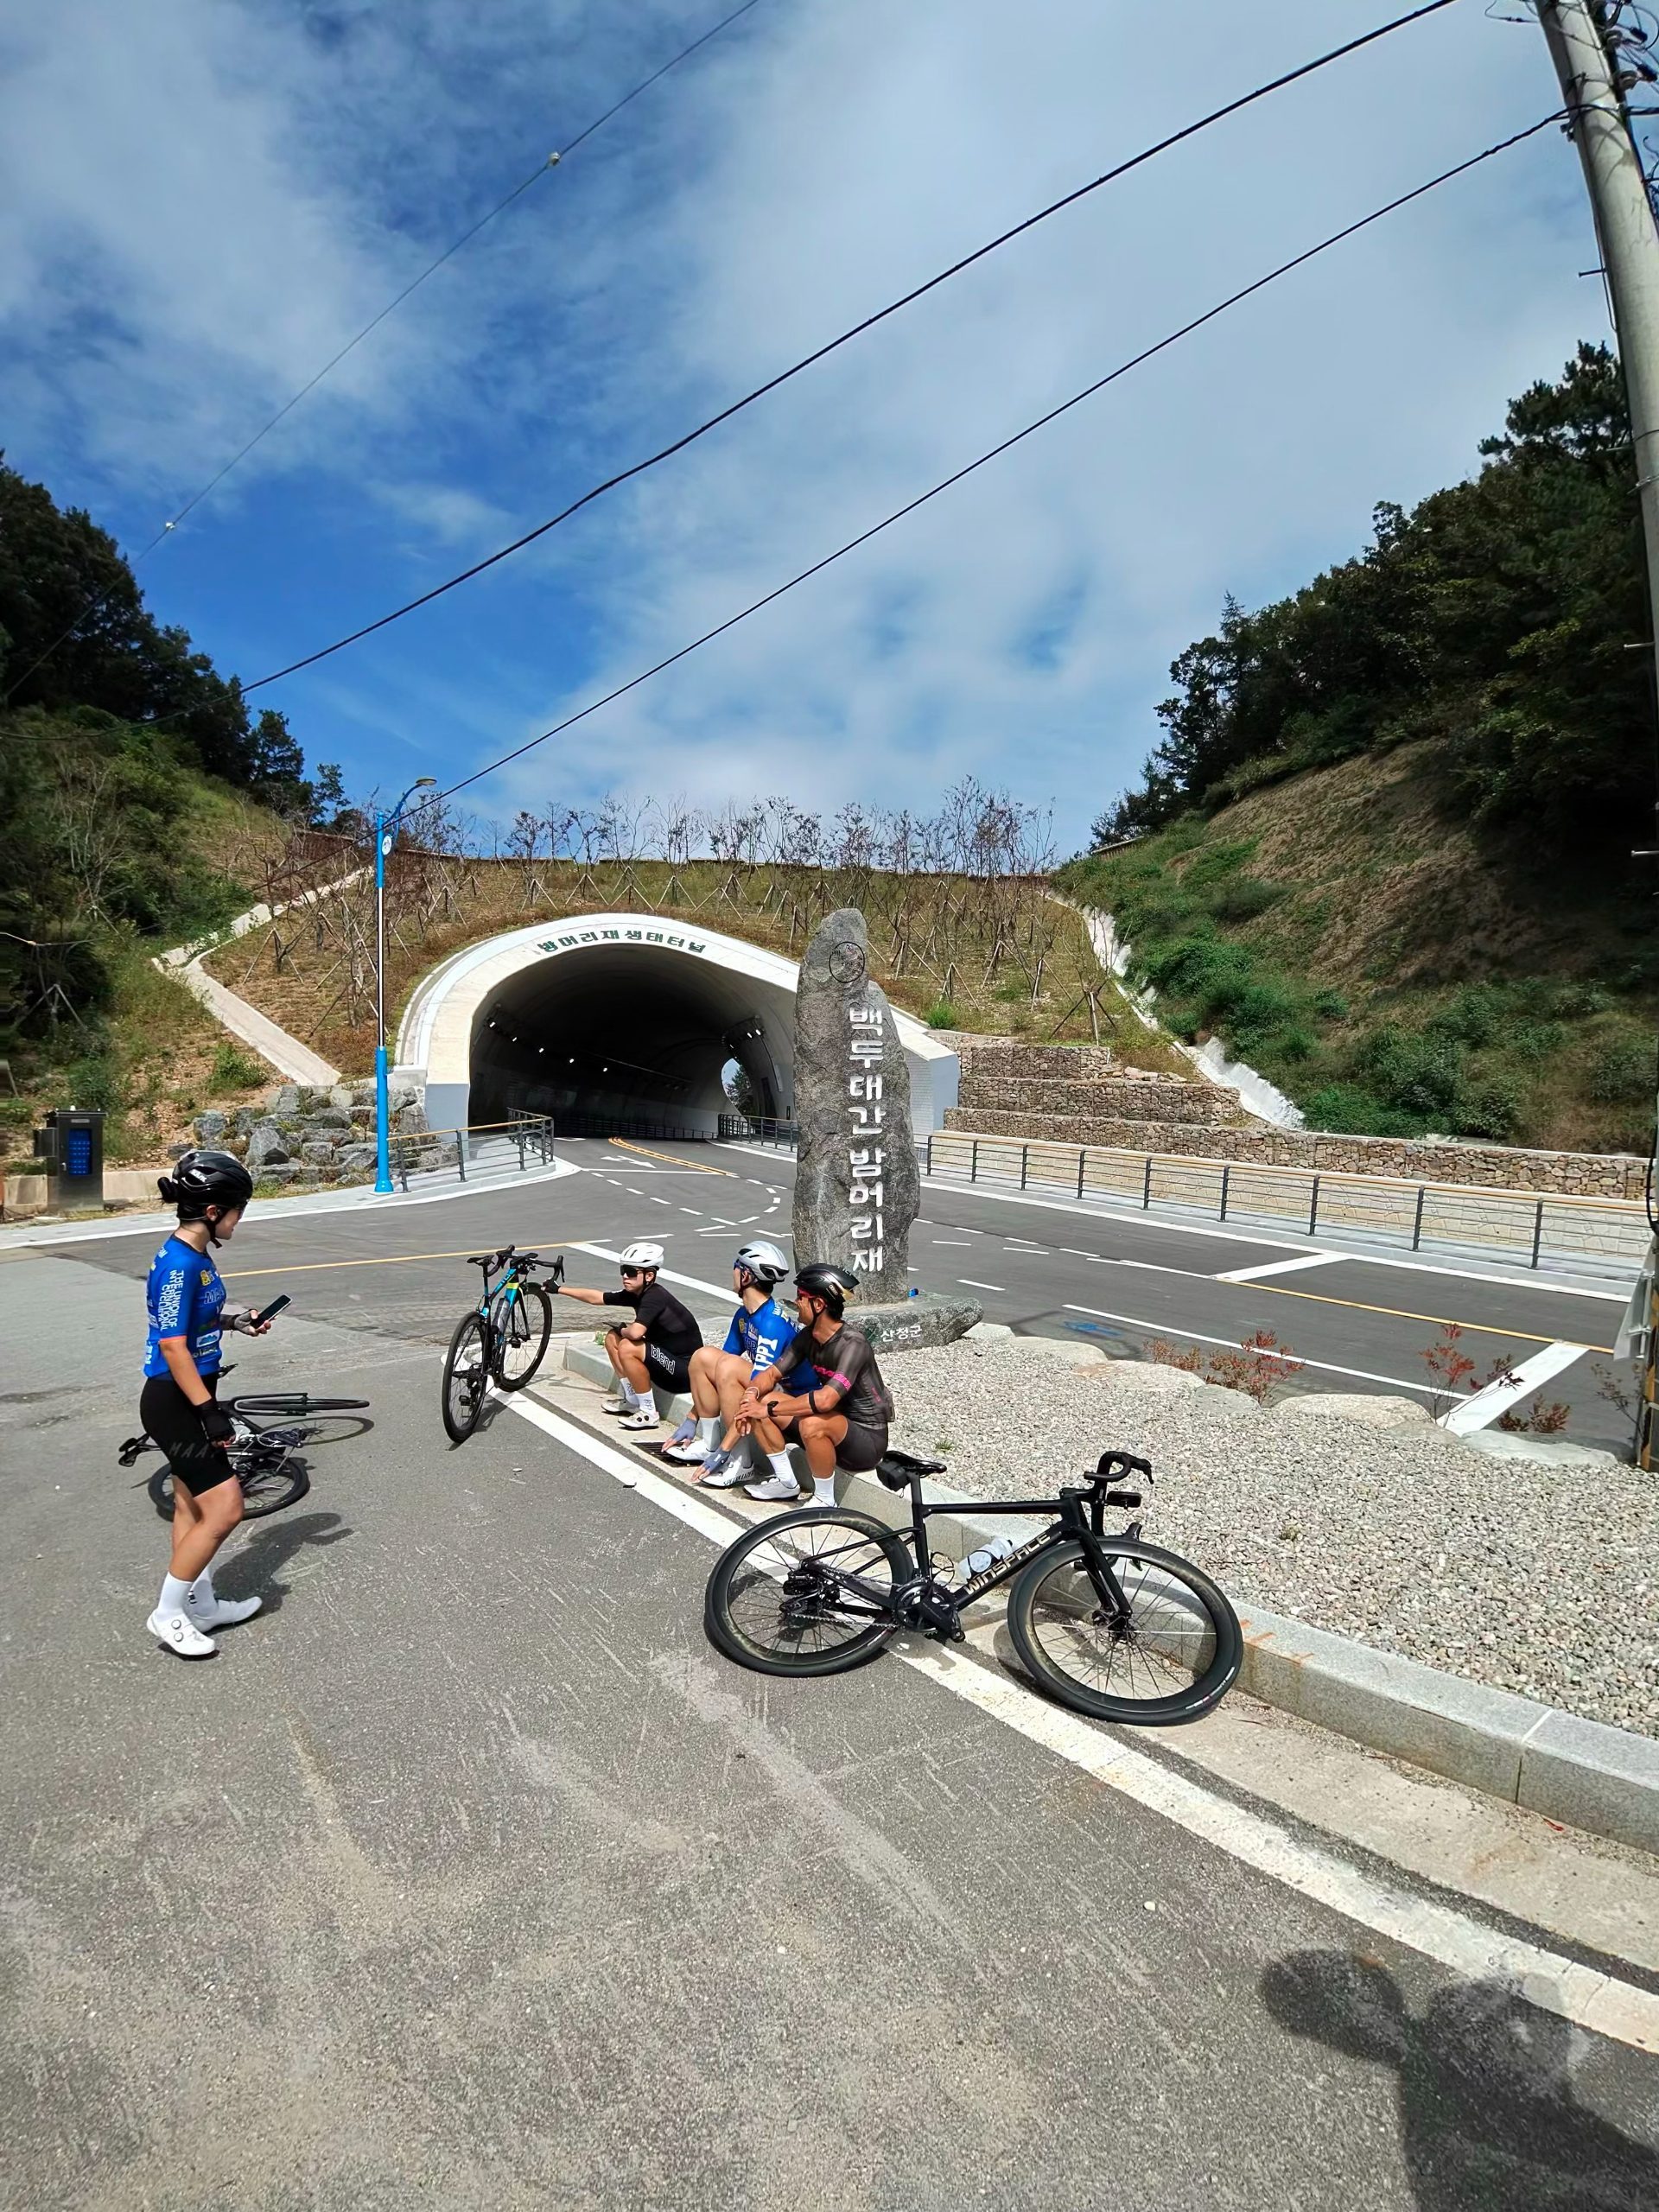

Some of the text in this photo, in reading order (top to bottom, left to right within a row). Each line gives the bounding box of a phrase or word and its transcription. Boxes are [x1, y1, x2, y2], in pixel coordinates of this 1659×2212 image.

[848, 1007, 887, 1272] 백두대간 밤머리재
[173, 1290, 182, 1317] UNION
[880, 1324, 922, 1342] 산청군
[651, 1344, 676, 1375] blend
[168, 1441, 216, 1459] MAA
[963, 1532, 1051, 1595] WINSPACE
